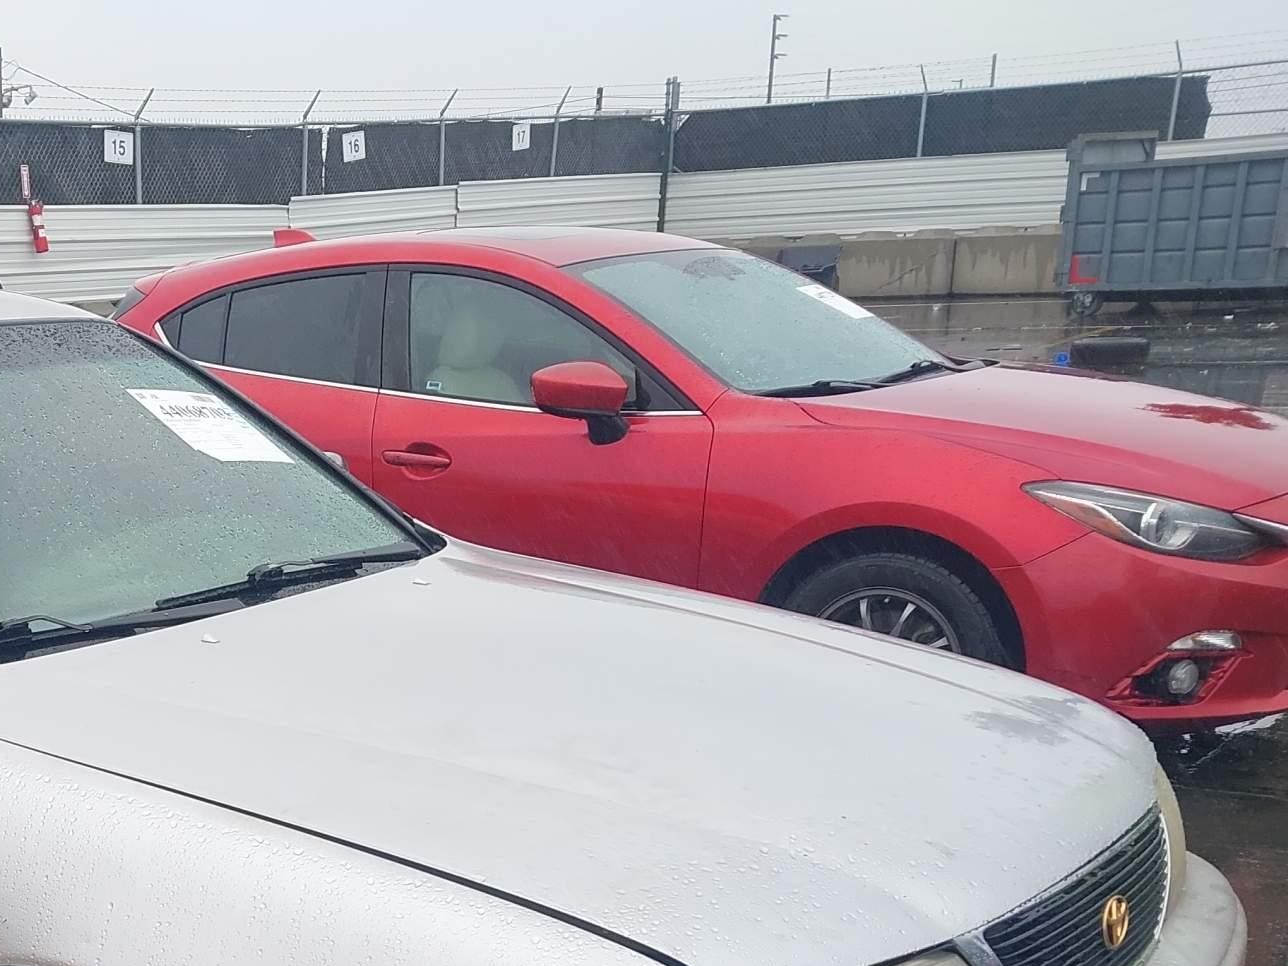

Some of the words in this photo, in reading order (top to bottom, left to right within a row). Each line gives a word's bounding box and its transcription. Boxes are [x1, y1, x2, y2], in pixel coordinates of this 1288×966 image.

[516, 130, 527, 145] 17
[111, 138, 127, 156] 15
[347, 138, 360, 155] 16
